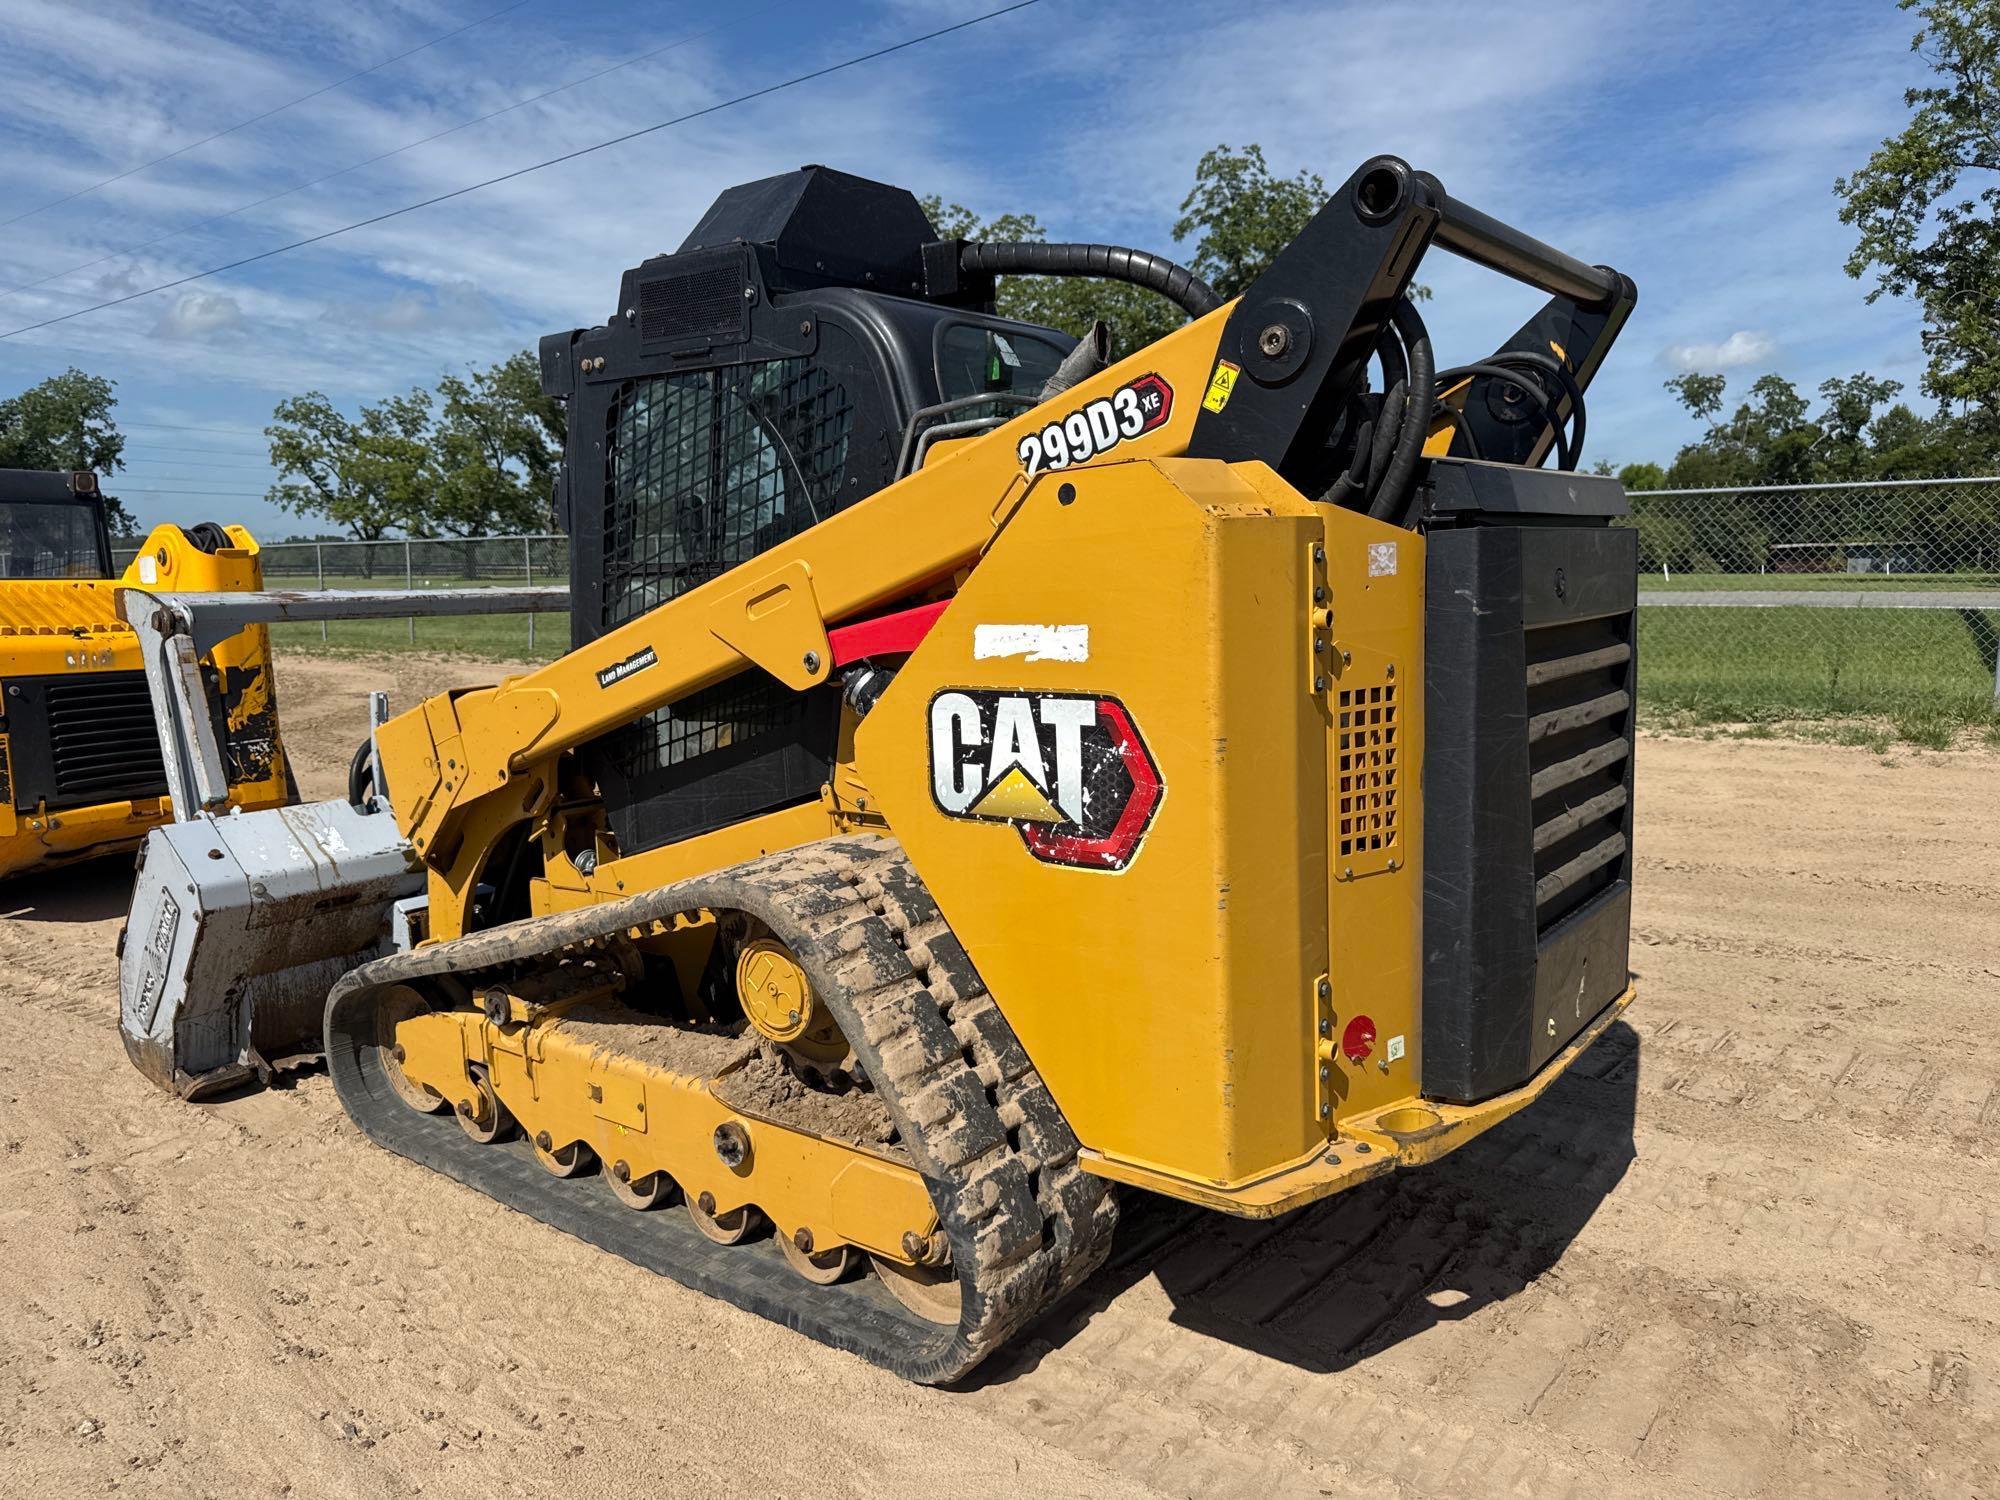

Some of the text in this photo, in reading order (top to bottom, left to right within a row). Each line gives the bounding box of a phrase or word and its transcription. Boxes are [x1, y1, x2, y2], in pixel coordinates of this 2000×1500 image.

[1019, 388, 1160, 477] 299D3 XE
[601, 651, 654, 685] LAND MANAGEMENT
[931, 692, 1096, 825] CAT
